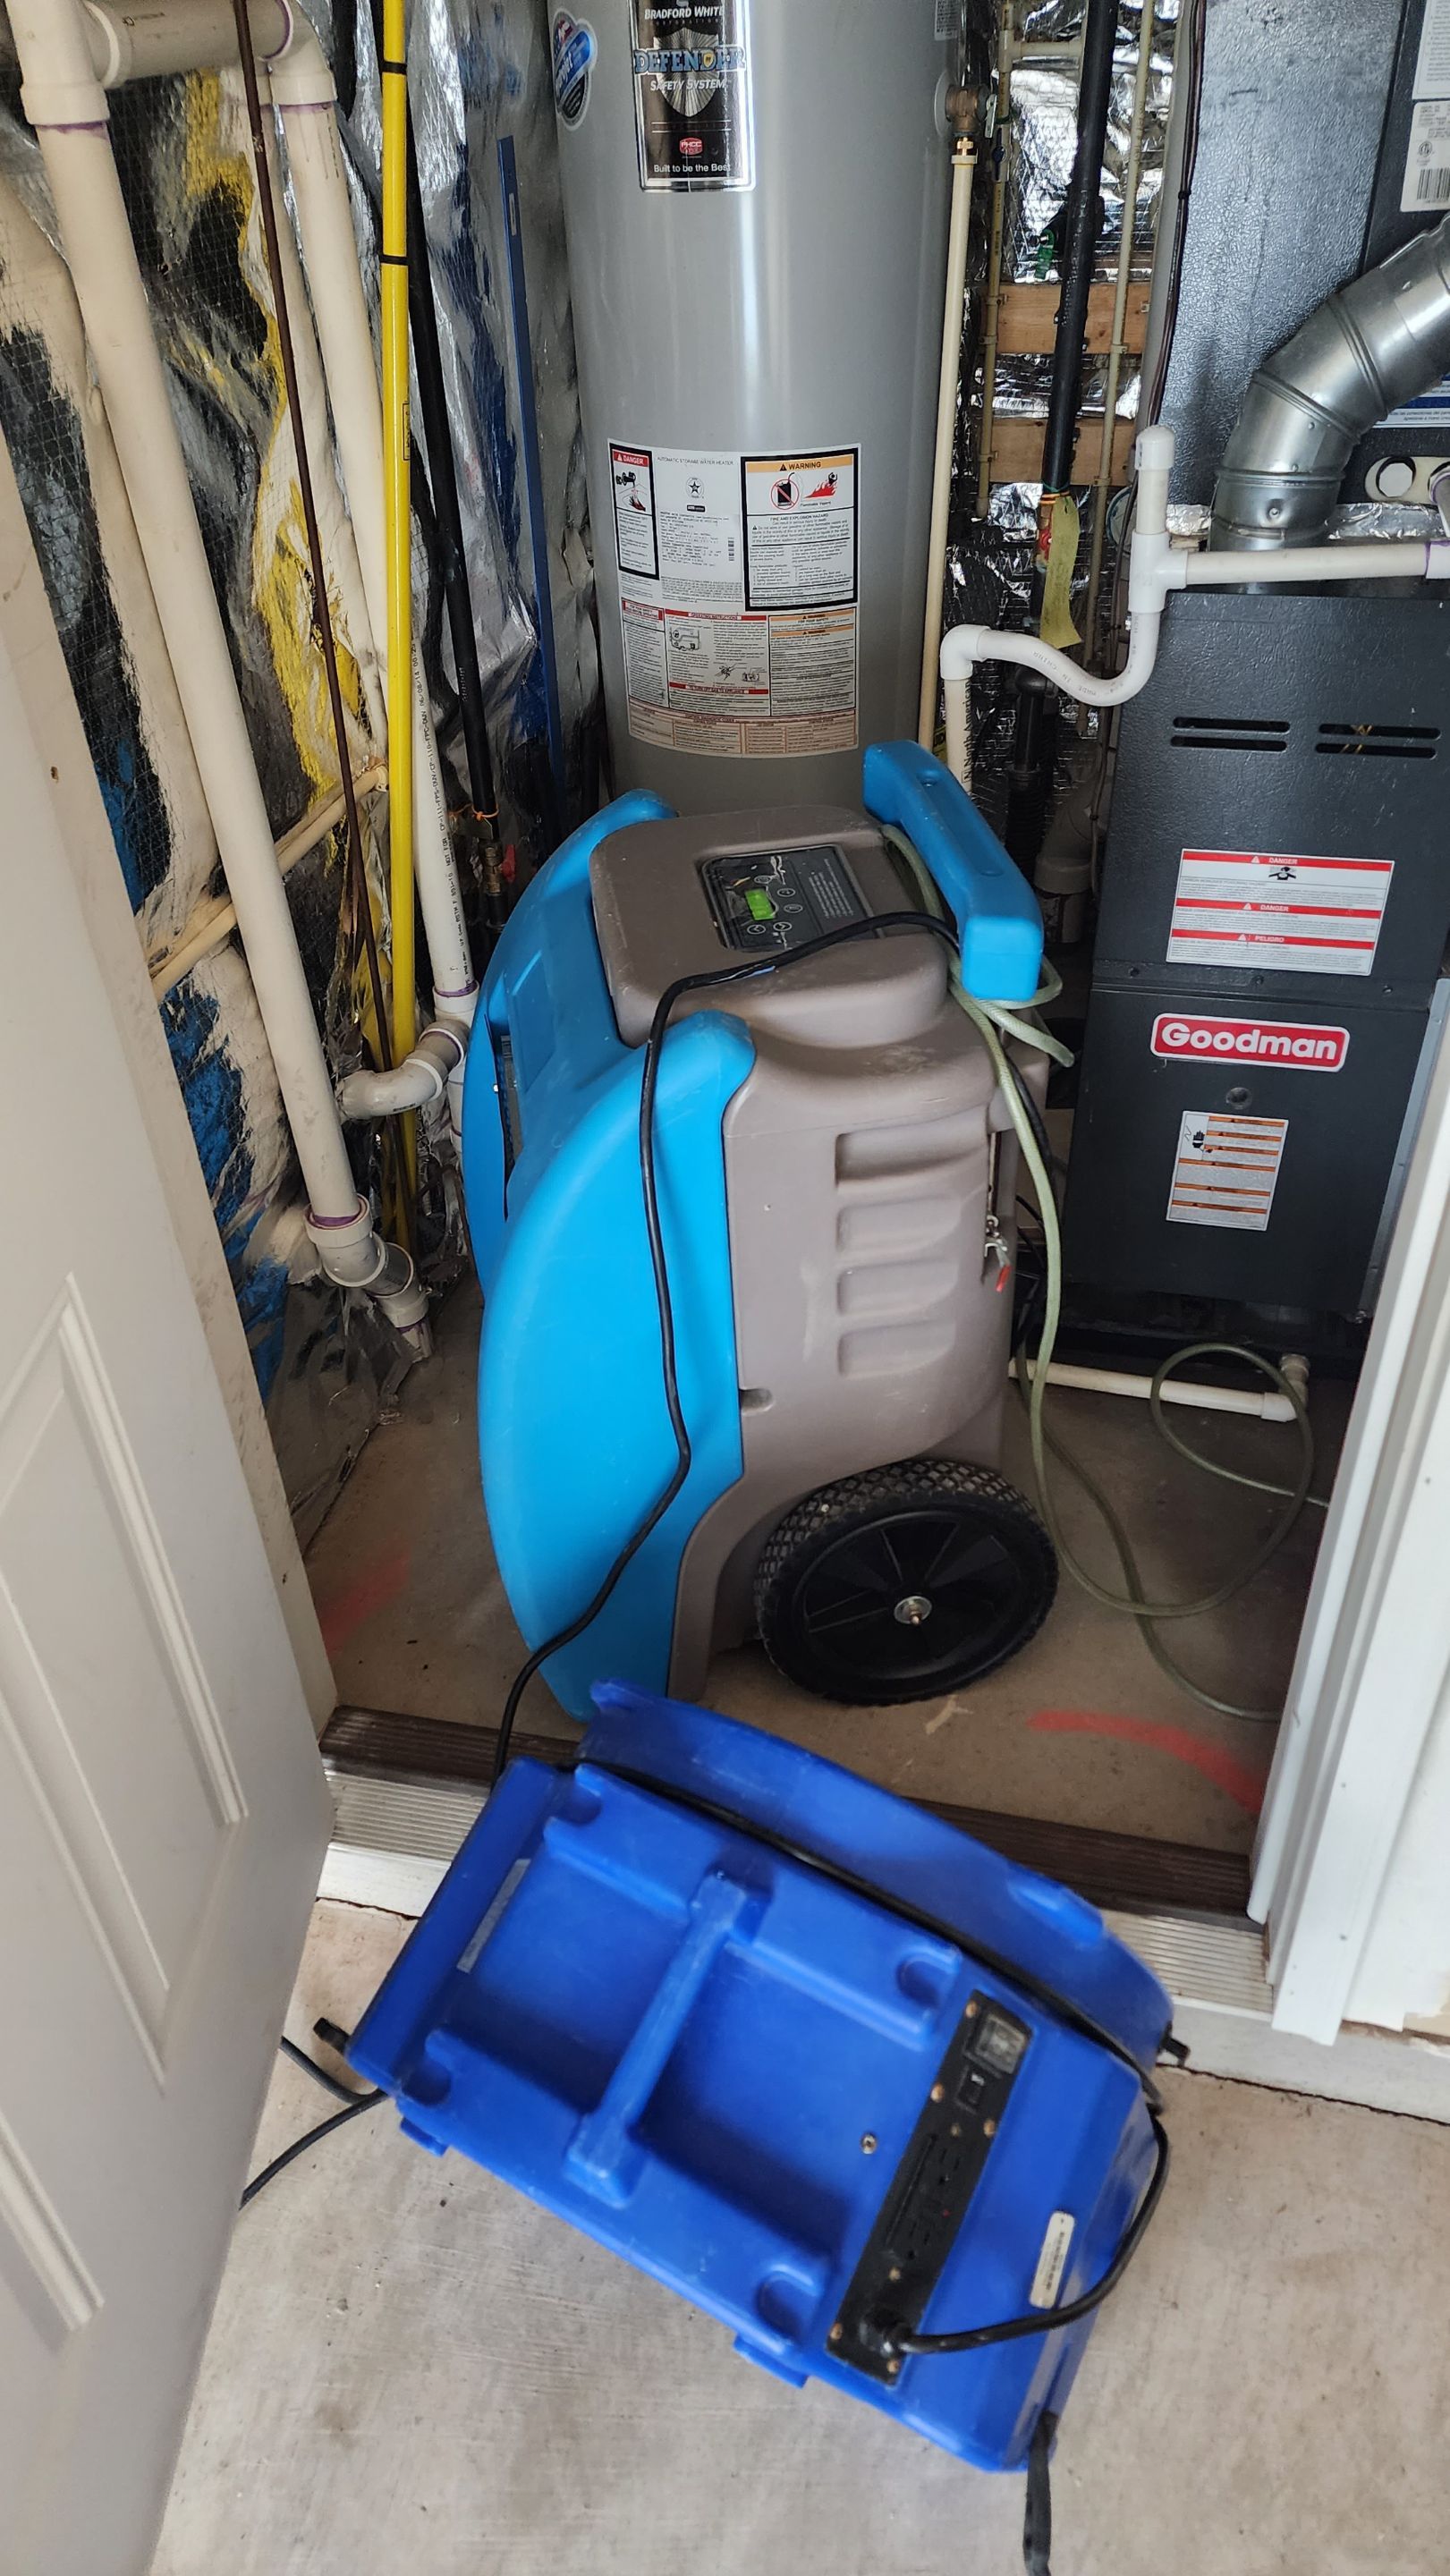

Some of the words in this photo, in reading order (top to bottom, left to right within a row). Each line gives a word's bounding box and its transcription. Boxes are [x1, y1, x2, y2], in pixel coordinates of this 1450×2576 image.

[645, 8, 691, 20] BRADFORD
[694, 5, 724, 17] WHITE
[634, 47, 746, 72] DEFENDER
[650, 80, 684, 91] SAFETY
[686, 79, 726, 90] SYSTEM
[654, 164, 670, 173] Built
[695, 164, 708, 172] the
[711, 163, 731, 172] Best
[623, 453, 644, 465] DANGER
[789, 462, 821, 470] WARNING
[962, 681, 973, 732] American
[963, 735, 973, 767] North
[1268, 857, 1298, 865] DANGER
[1260, 903, 1289, 912] DANGER
[1255, 935, 1285, 943] PELIGRO
[1161, 1022, 1337, 1060] Goodman
